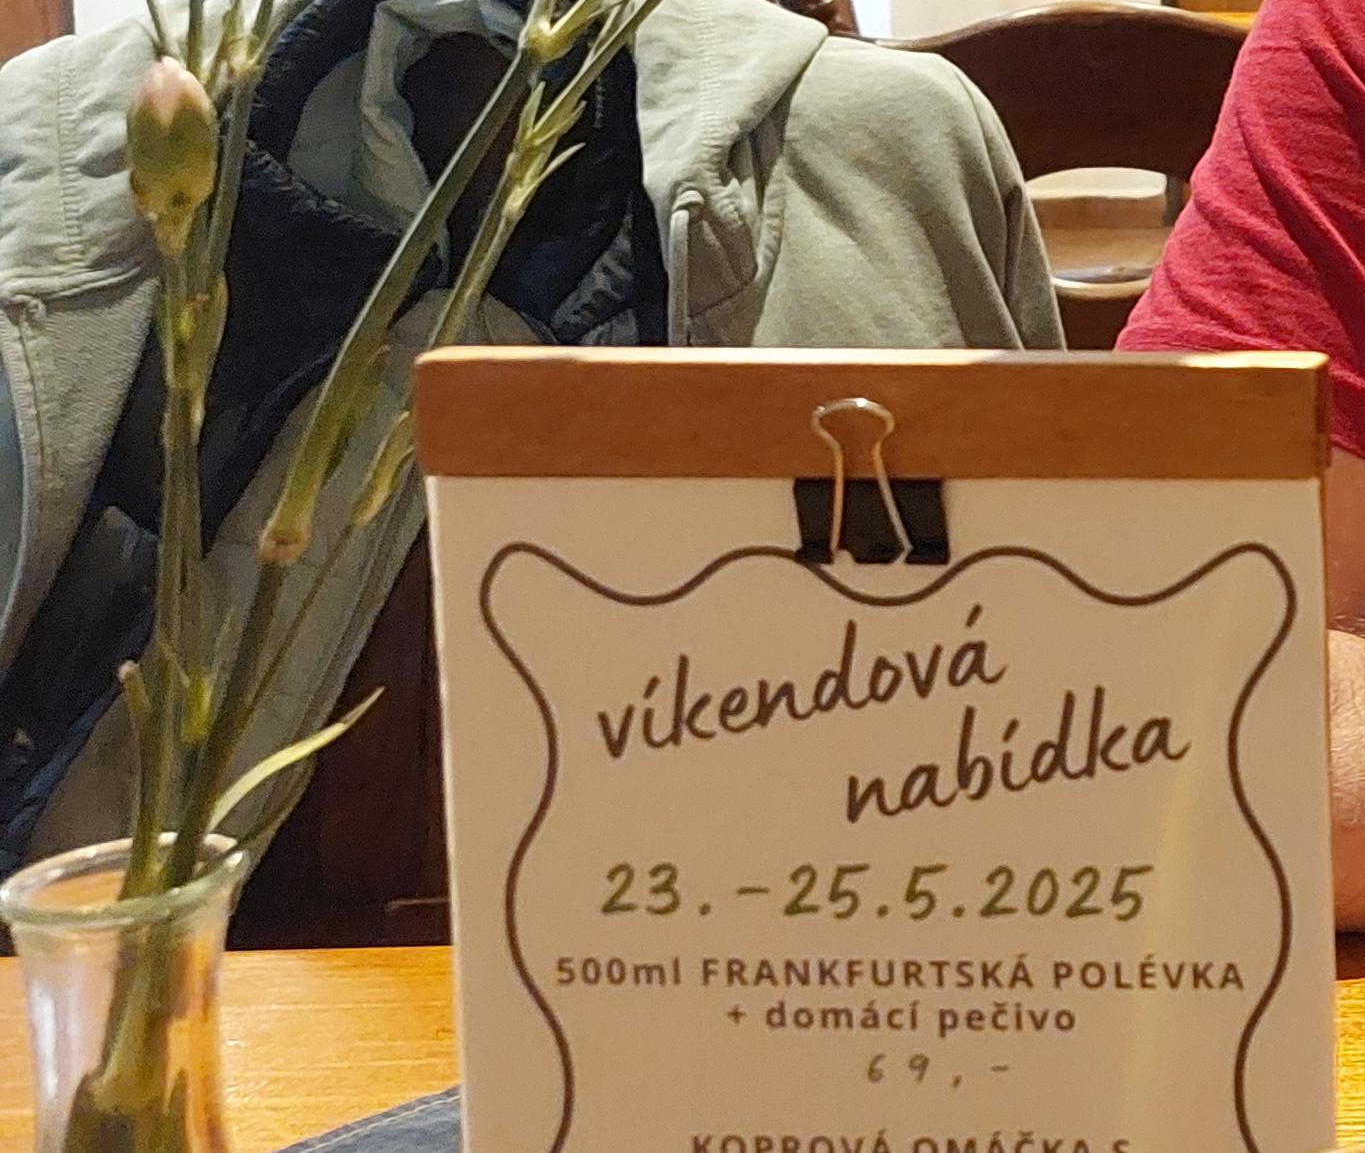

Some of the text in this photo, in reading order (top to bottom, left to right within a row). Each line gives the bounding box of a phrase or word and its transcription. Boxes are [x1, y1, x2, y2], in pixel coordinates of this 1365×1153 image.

[597, 603, 1008, 759] víkendová
[846, 684, 1192, 824] nabídka
[556, 953, 1245, 992] 500ml FRANKFURTSKÁ POLÉVKA
[727, 998, 1077, 1040] + domácí pečivo
[692, 1128, 891, 1153] KOPROVÁ
[912, 1131, 1093, 1153] OMÁČKA
